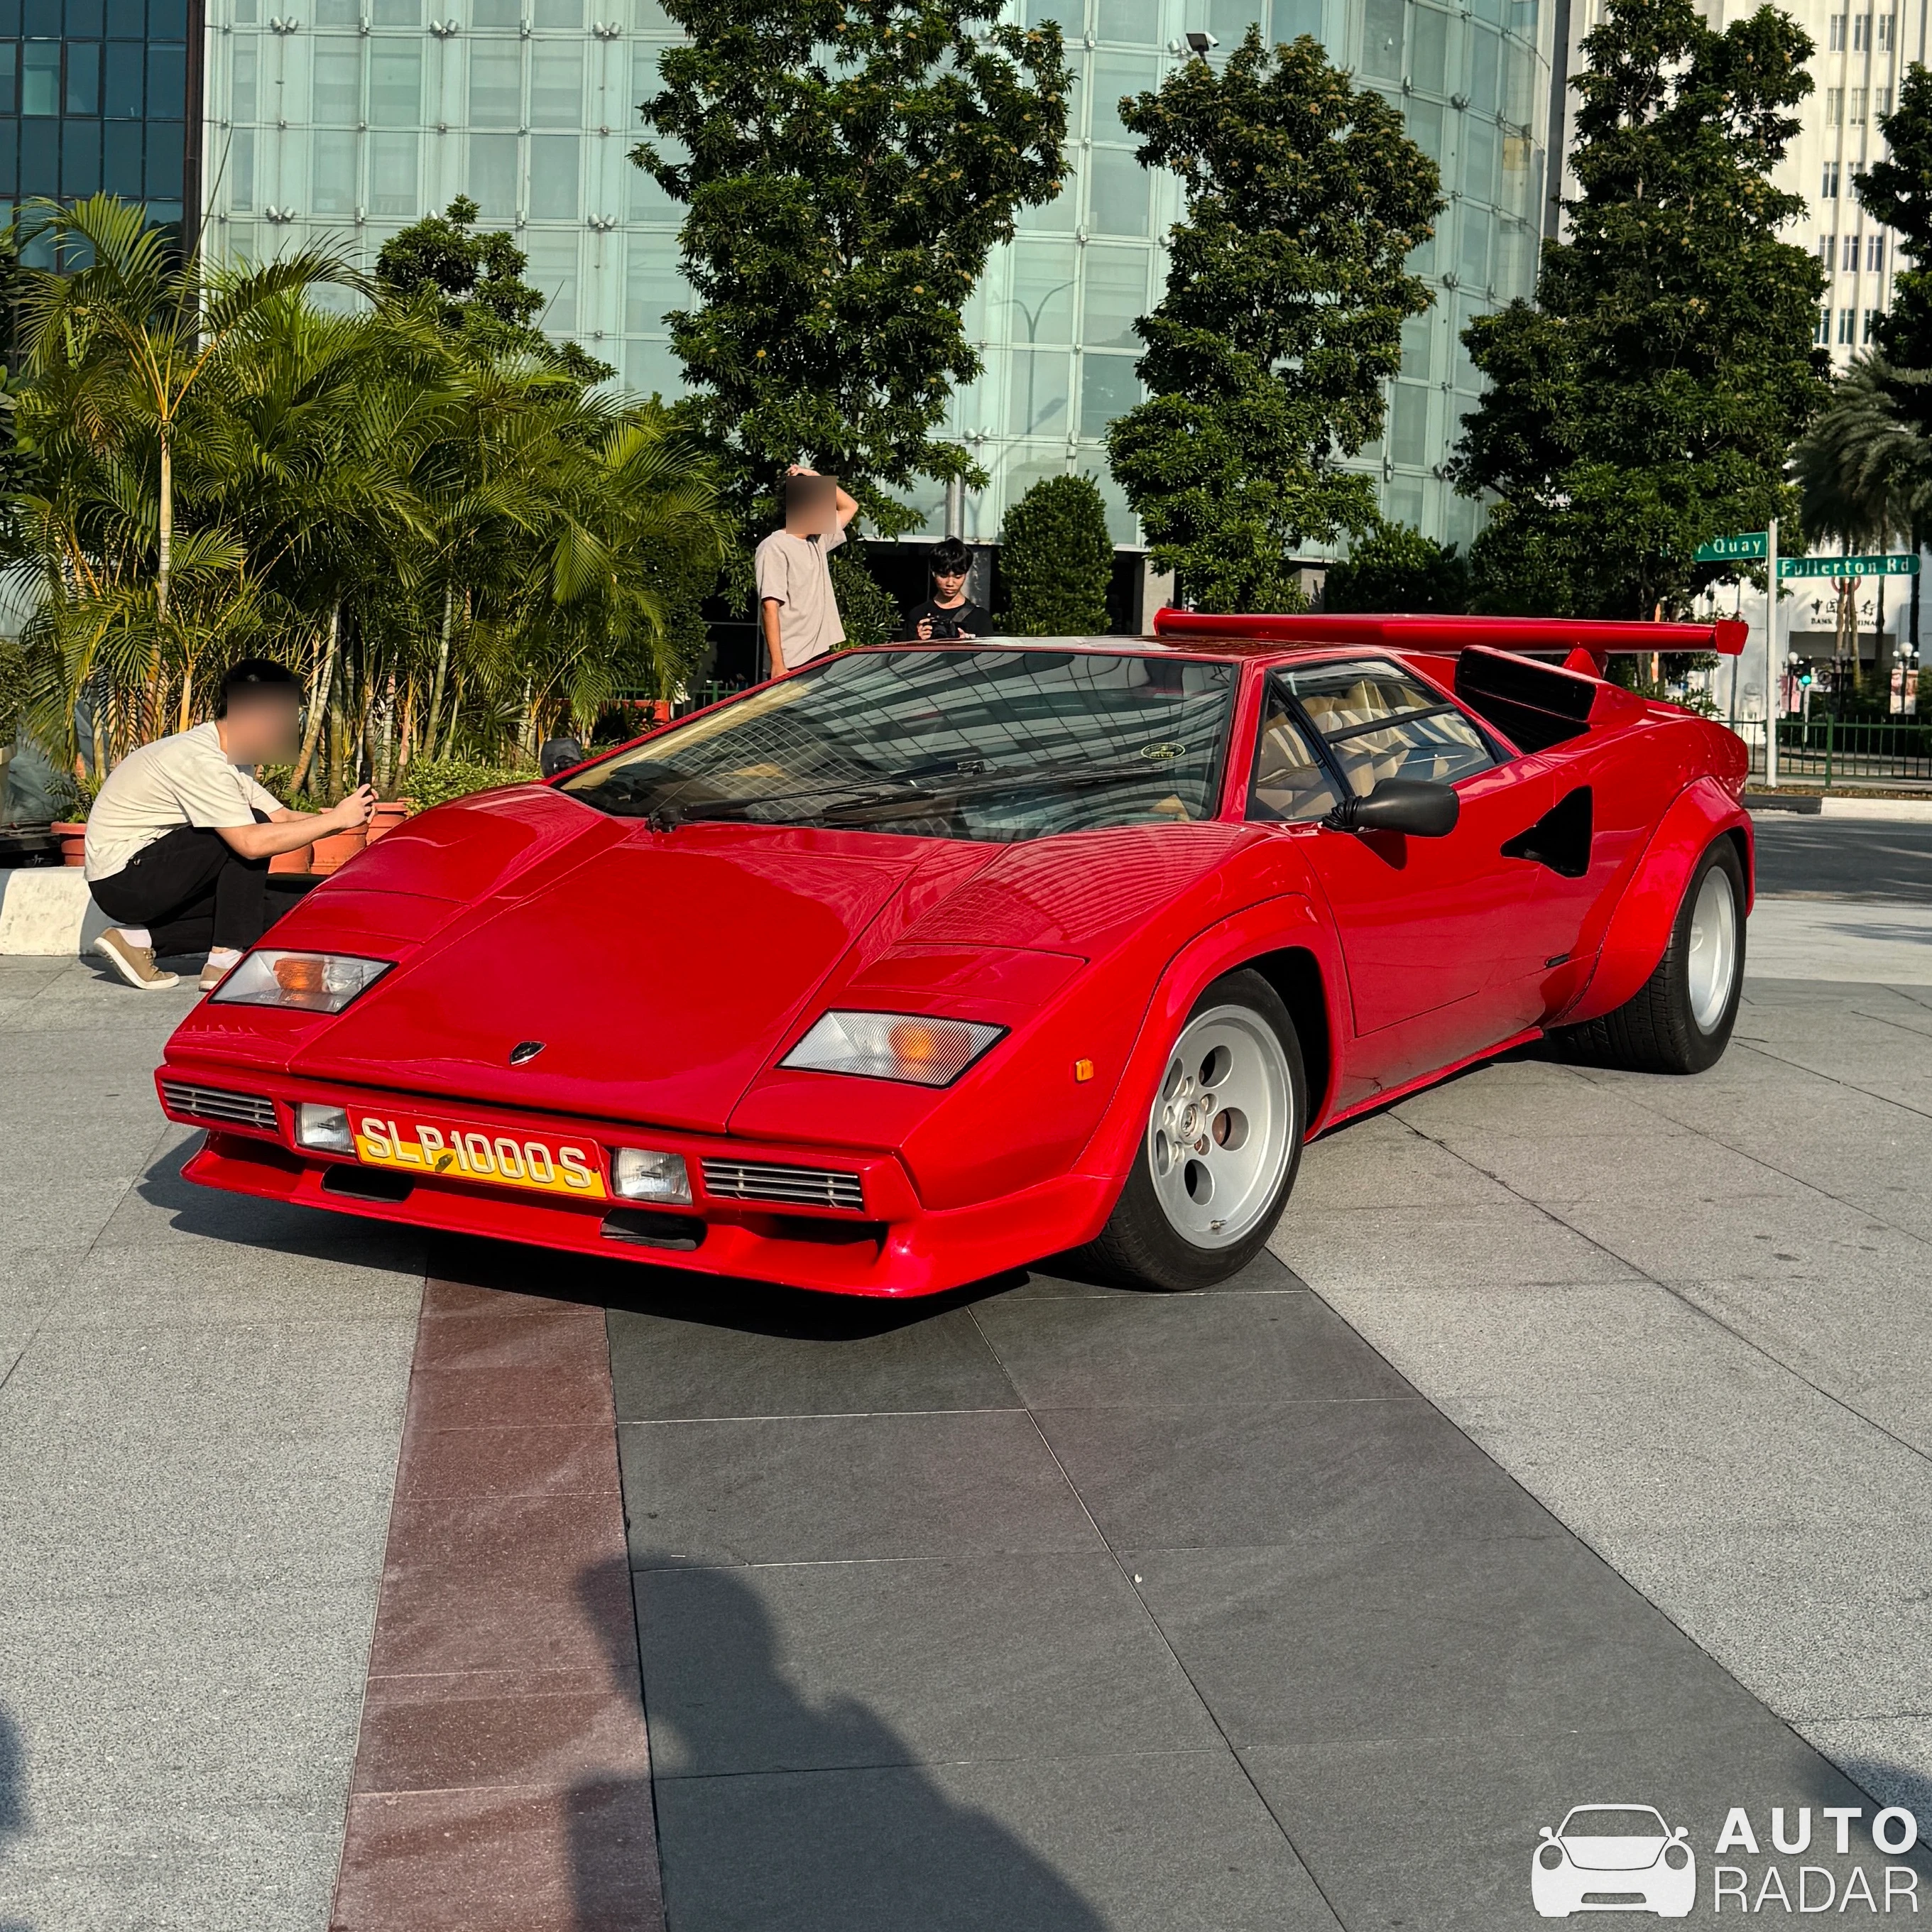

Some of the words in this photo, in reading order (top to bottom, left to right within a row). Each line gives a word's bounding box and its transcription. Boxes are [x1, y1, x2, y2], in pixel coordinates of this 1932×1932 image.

[1713, 538, 1761, 555] Quay
[1781, 560, 1877, 576] Fullerton
[1887, 557, 1909, 573] Rd
